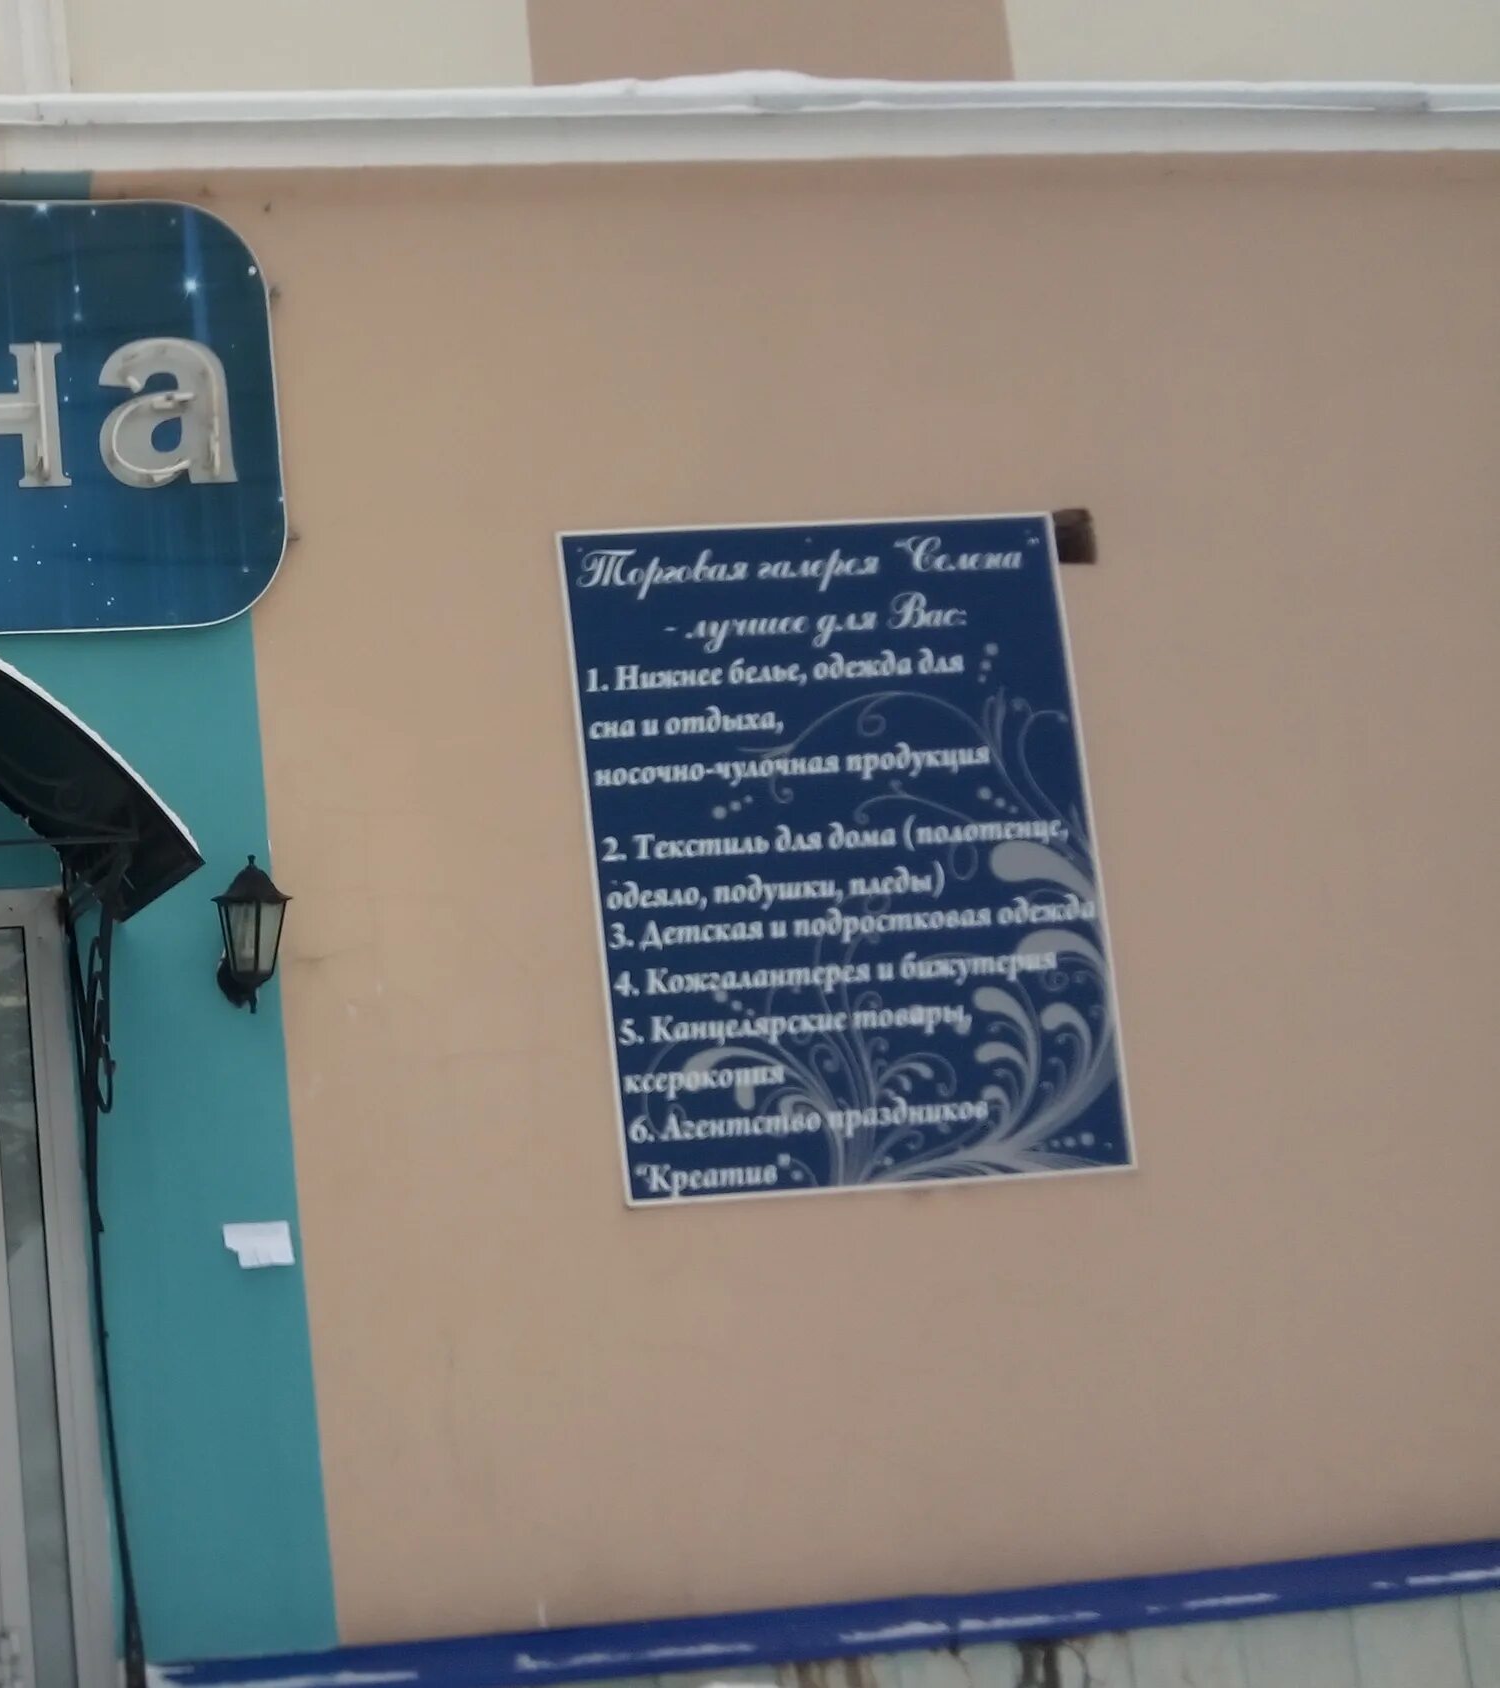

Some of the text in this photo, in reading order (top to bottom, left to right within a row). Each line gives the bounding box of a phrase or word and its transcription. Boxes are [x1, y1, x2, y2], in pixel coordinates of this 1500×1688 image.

[576, 549, 749, 601] Торговая
[757, 548, 880, 592] галерея
[684, 615, 809, 654] лучшее
[812, 611, 878, 648] для
[586, 647, 964, 692] 1. Нижнее белье, одежда для
[589, 705, 785, 740] сна и отдыха,
[594, 742, 990, 787] носочно-чулочная продукция
[601, 836, 627, 862] 2.
[632, 834, 770, 860] Текстиль
[775, 824, 823, 852] для
[828, 821, 896, 850] дома
[606, 860, 946, 912] одеяло, подушки, пледы)
[608, 893, 1096, 951] 3. Детская и подростковая одежда
[614, 951, 1058, 997] 4. Кожгалантерея и бижутерия
[618, 1004, 973, 1047] 5. Канцелярские товары,
[623, 1064, 786, 1100] ксерокопия
[628, 1096, 989, 1144] 6. Агентство праздников
